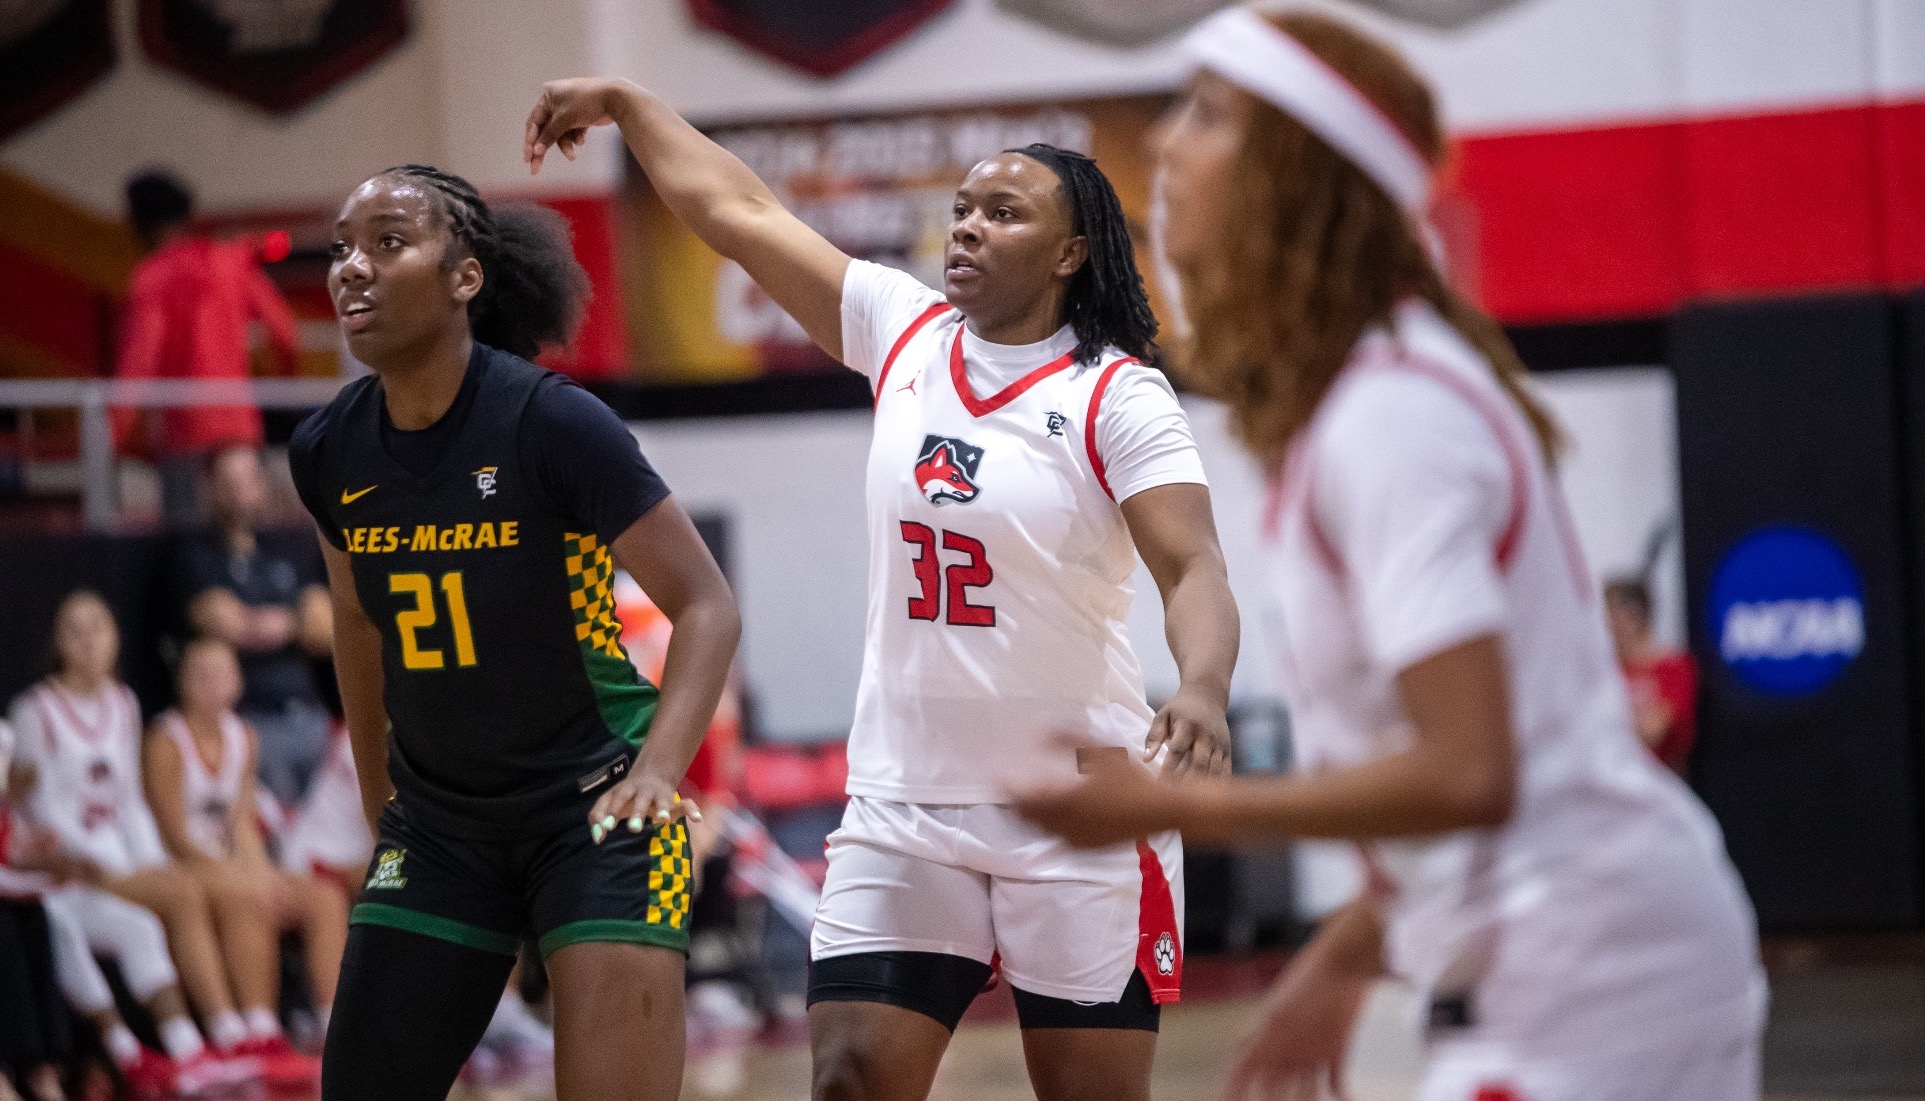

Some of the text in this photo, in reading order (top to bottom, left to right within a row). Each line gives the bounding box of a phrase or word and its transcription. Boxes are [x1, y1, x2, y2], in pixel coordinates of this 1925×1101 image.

[899, 519, 996, 627] 32
[389, 571, 478, 670] 21
[1720, 597, 1865, 662] NCAA
[613, 763, 624, 775] M
